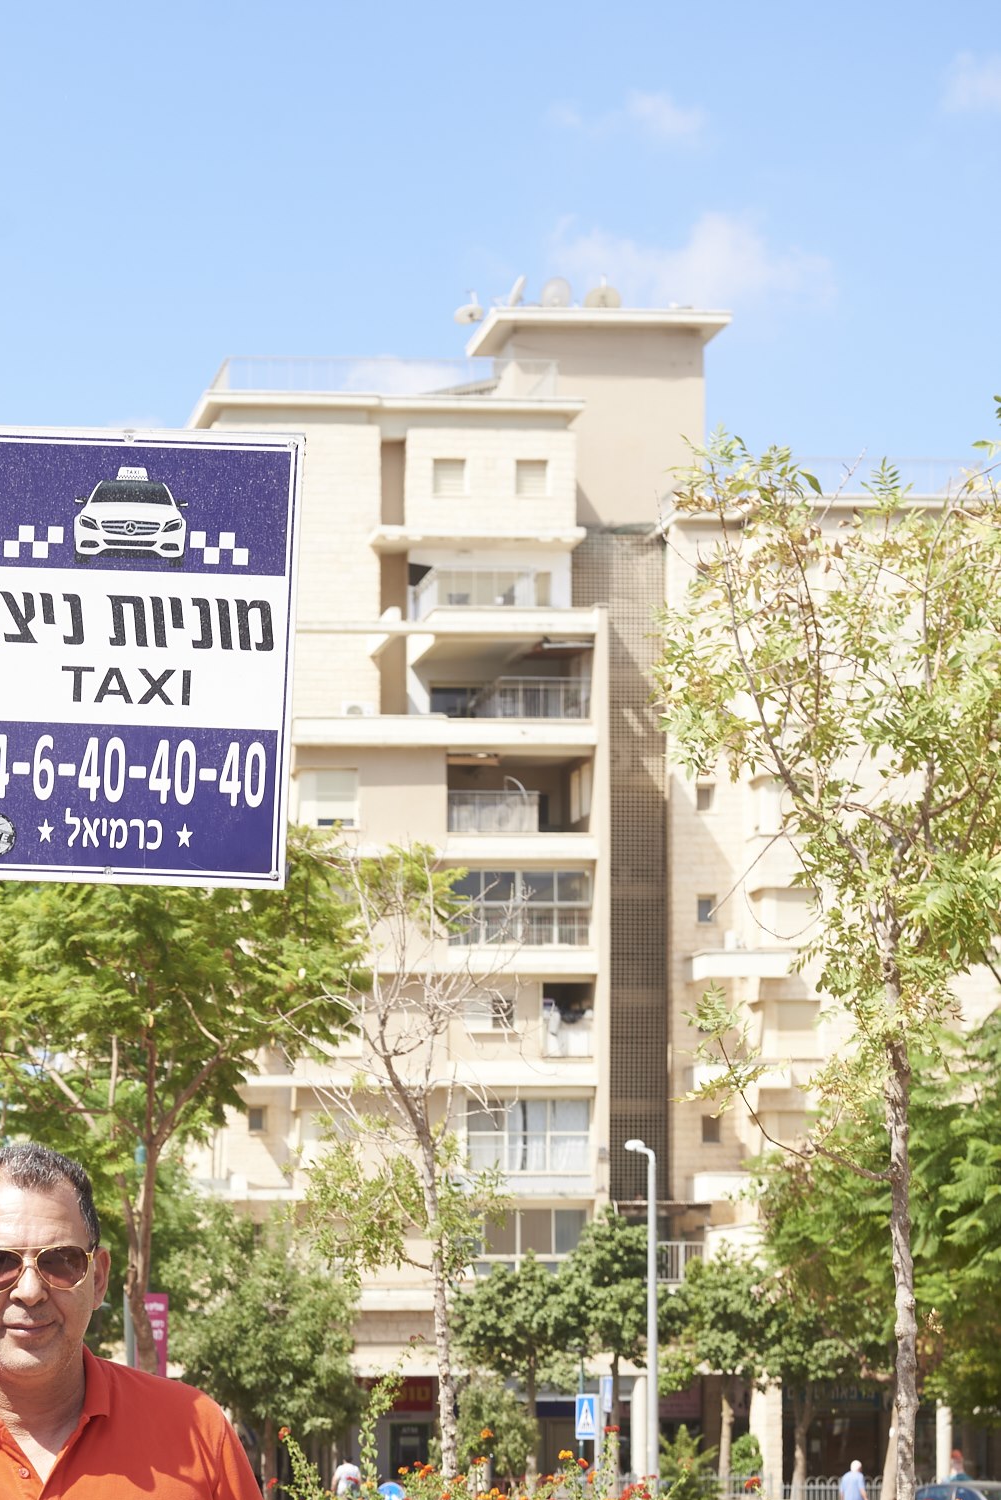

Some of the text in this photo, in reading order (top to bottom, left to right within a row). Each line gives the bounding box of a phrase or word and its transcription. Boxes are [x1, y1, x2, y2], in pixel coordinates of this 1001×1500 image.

[107, 595, 274, 651] מוניות
[62, 666, 191, 706] TAXI
[65, 808, 162, 849] כרמיאל
